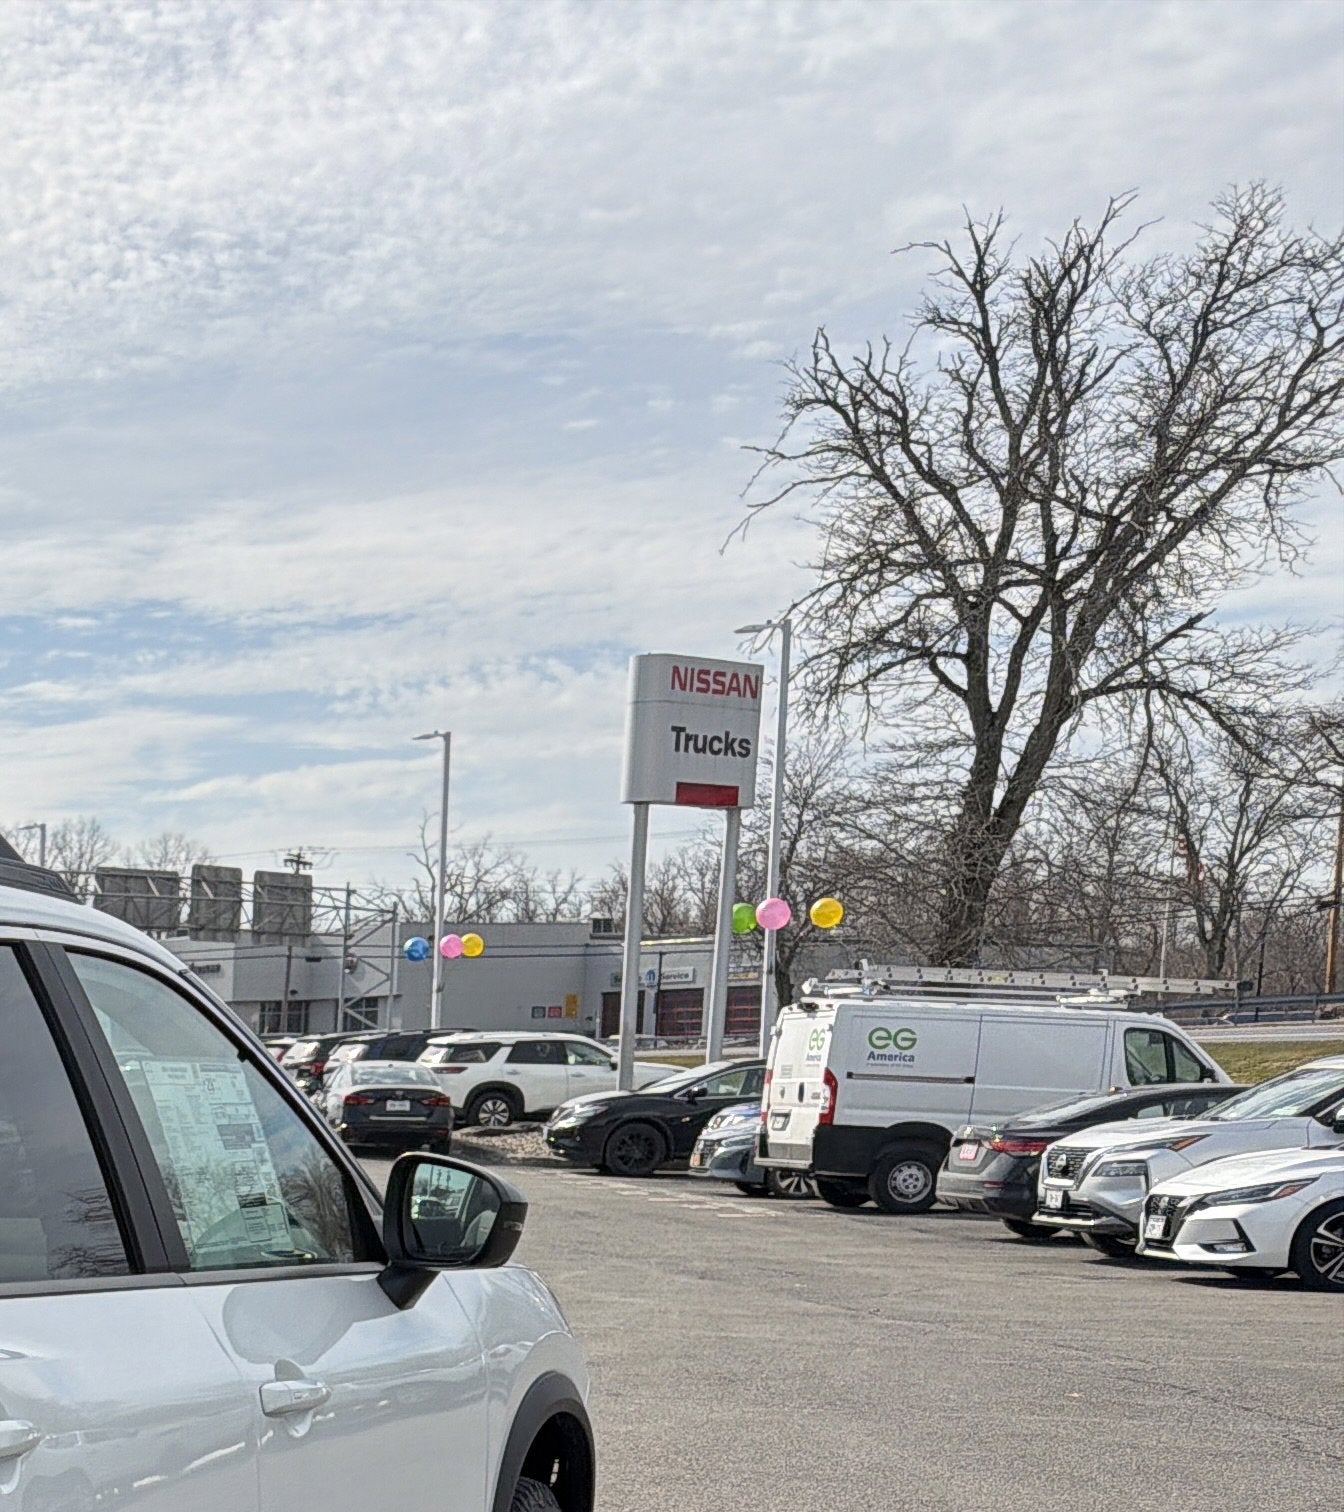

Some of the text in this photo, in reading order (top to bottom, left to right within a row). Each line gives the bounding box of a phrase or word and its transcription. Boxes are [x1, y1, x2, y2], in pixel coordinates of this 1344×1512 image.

[670, 665, 760, 699] NISSAN
[670, 725, 752, 758] Trucks
[866, 1050, 915, 1063] America
